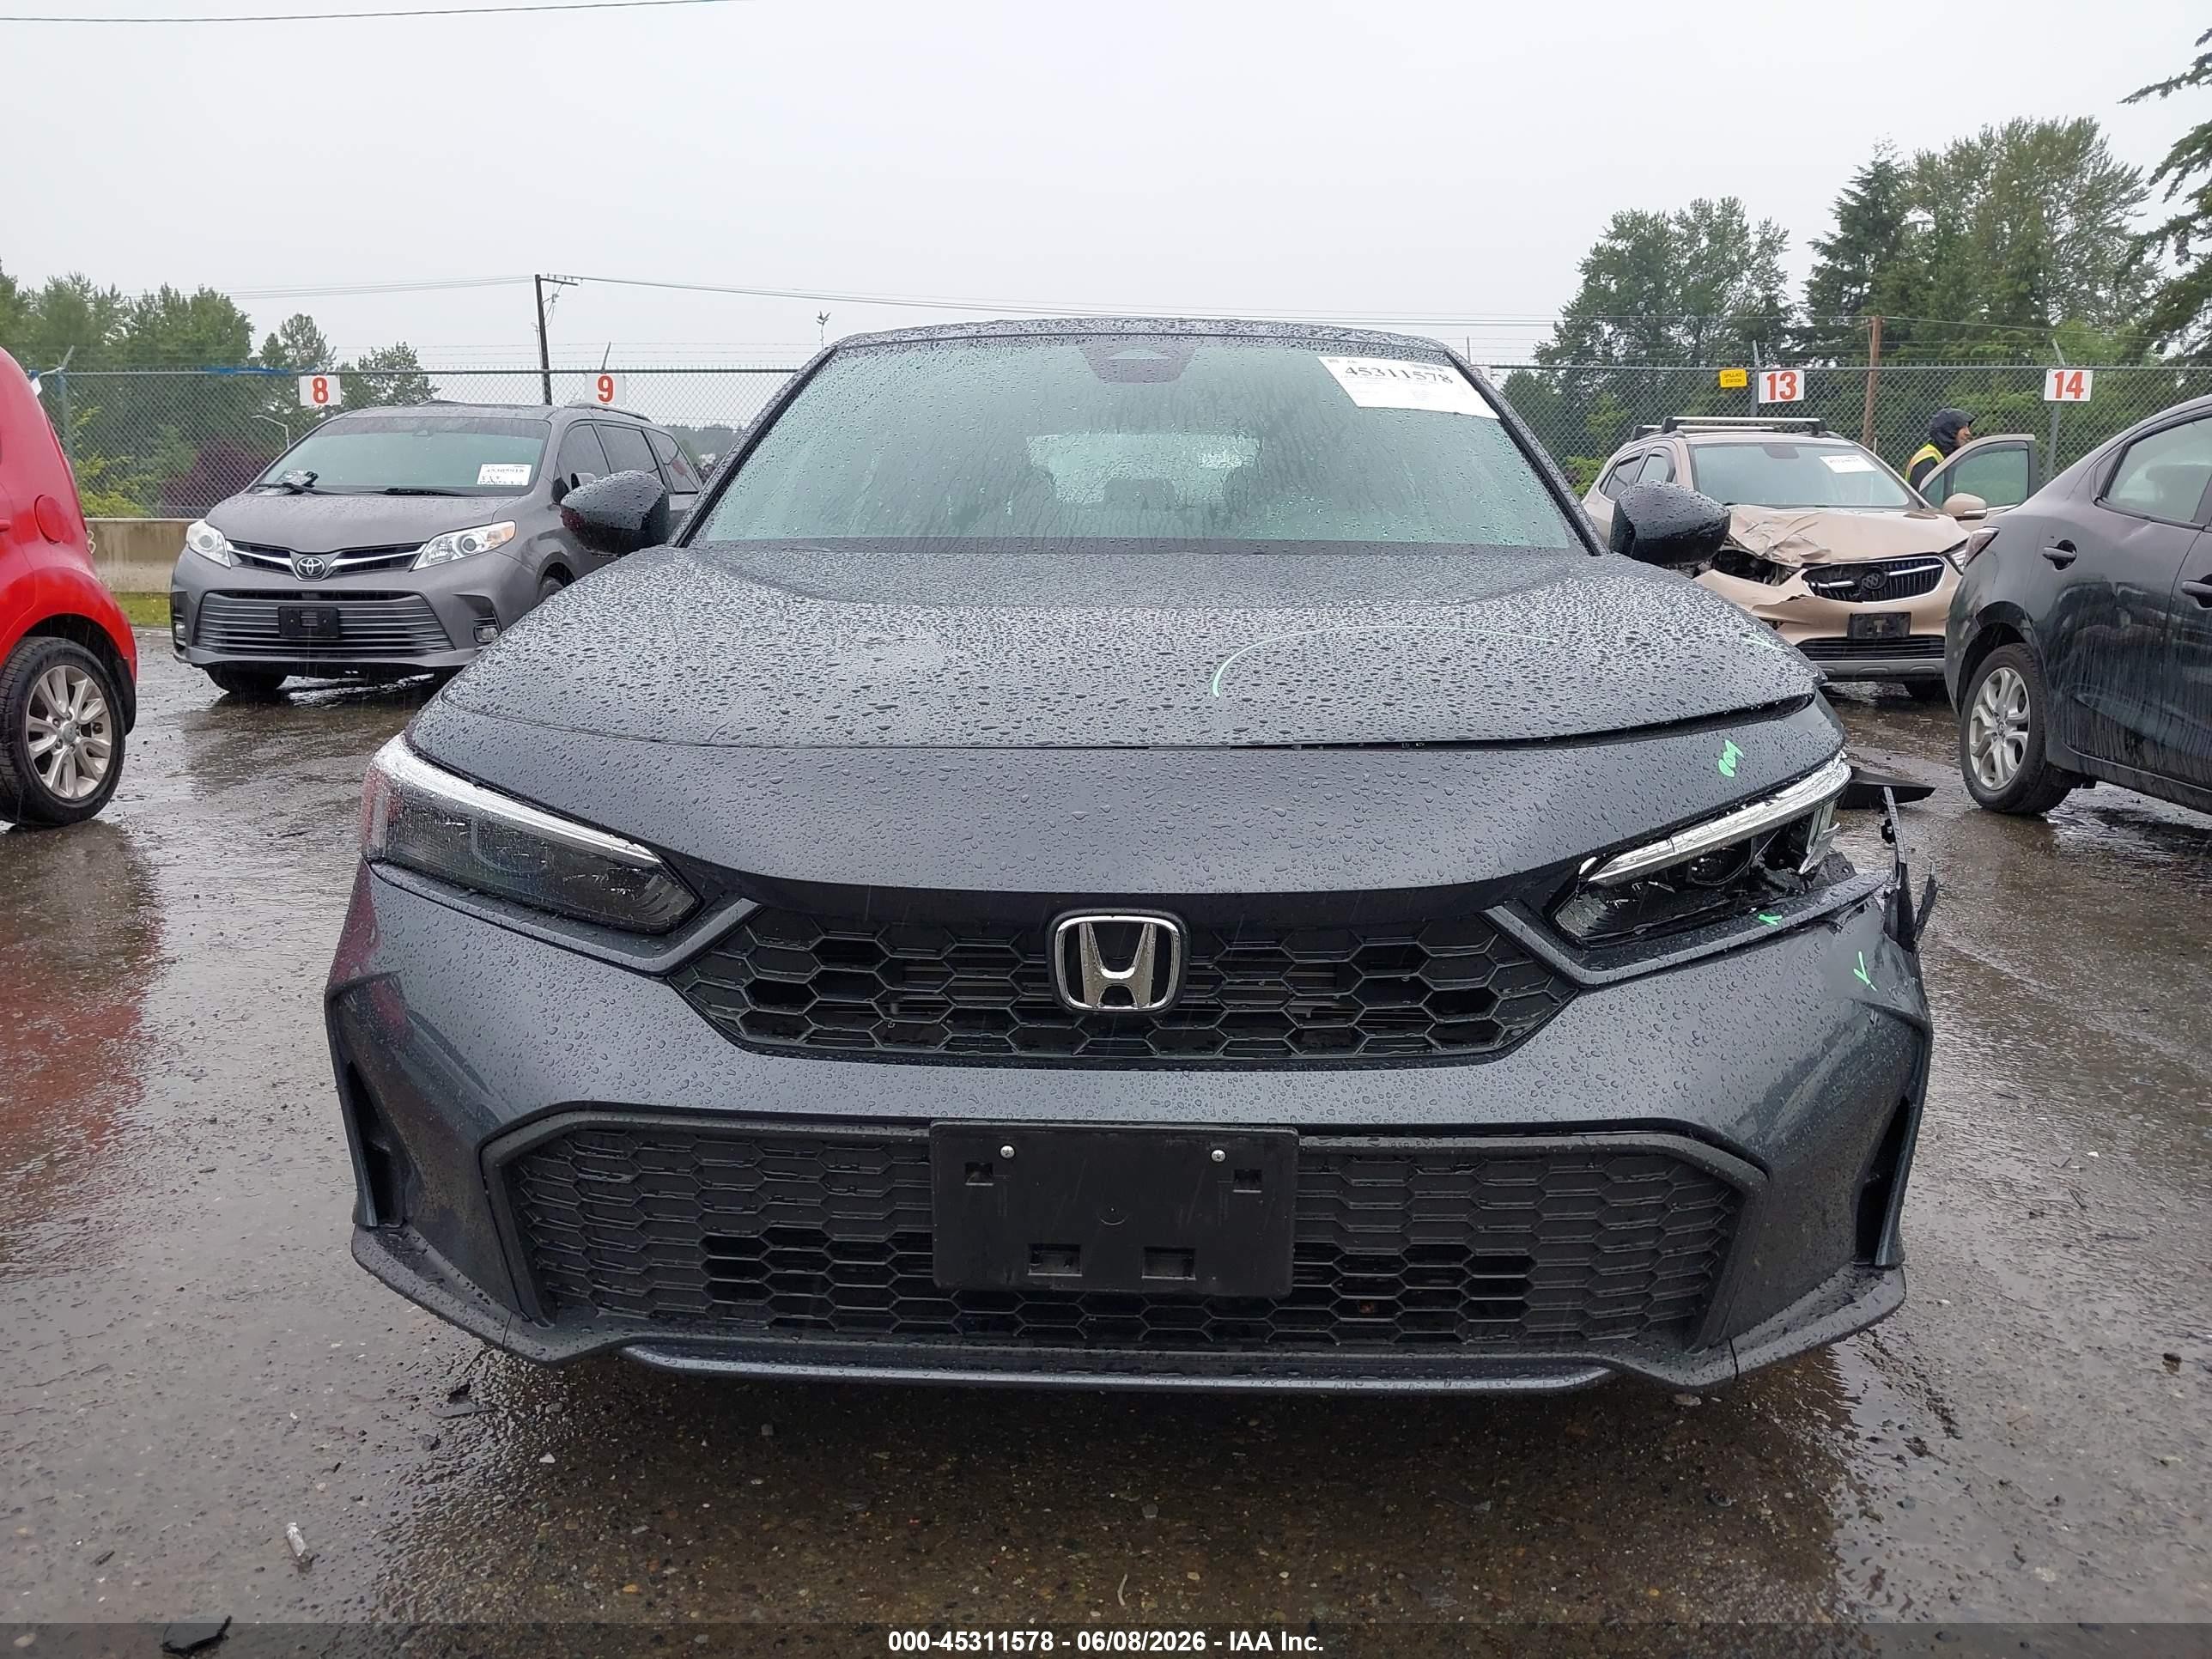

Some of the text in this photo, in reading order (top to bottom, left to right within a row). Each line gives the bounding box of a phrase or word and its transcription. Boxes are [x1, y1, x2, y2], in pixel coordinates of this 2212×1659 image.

[598, 375, 613, 402] 9
[1345, 366, 1454, 385] 45311578
[1767, 372, 1797, 400] 13
[2055, 371, 2083, 399] 14
[313, 377, 328, 404] 8
